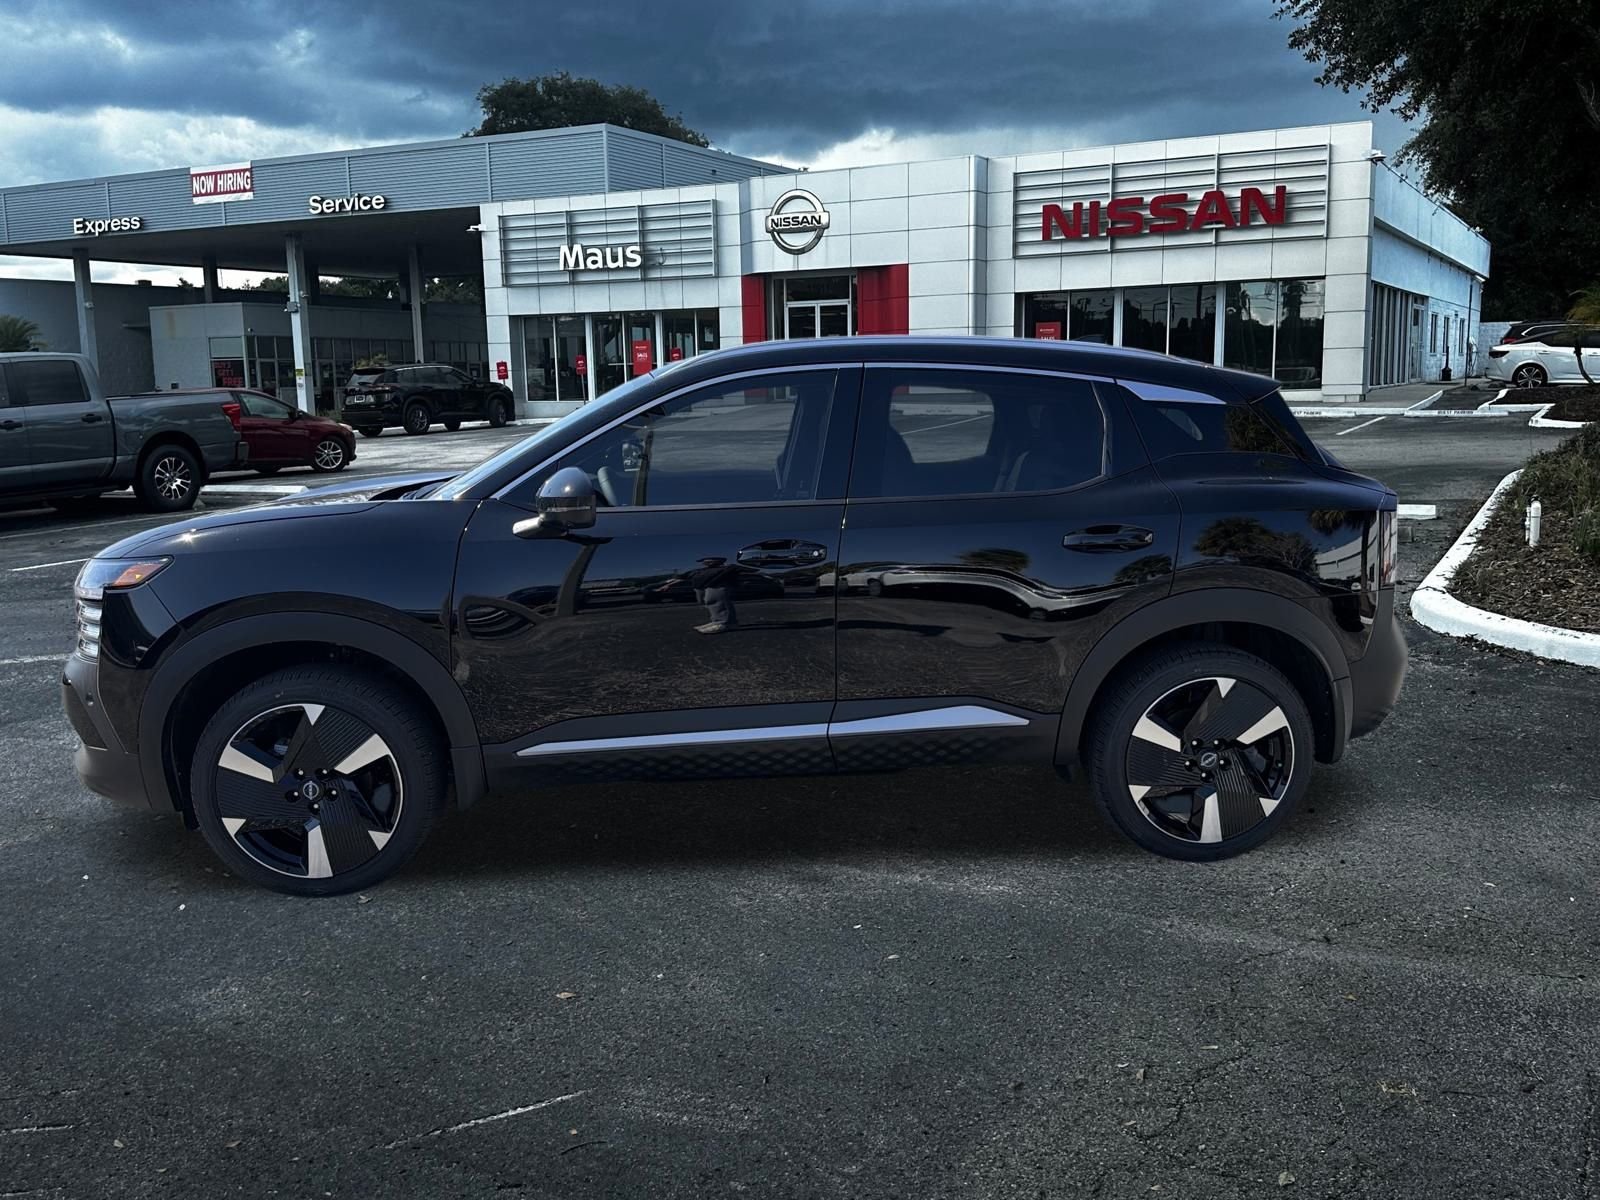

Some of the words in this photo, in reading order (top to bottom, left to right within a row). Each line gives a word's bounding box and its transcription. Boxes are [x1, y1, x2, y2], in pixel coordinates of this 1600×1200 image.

[192, 175, 215, 195] NOW
[217, 171, 251, 193] HIRING
[309, 193, 385, 215] Service
[1042, 185, 1286, 241] NISSAN
[73, 216, 141, 237] Express
[770, 215, 822, 228] NISSAN
[559, 243, 642, 271] Maus
[222, 376, 244, 386] FREE
